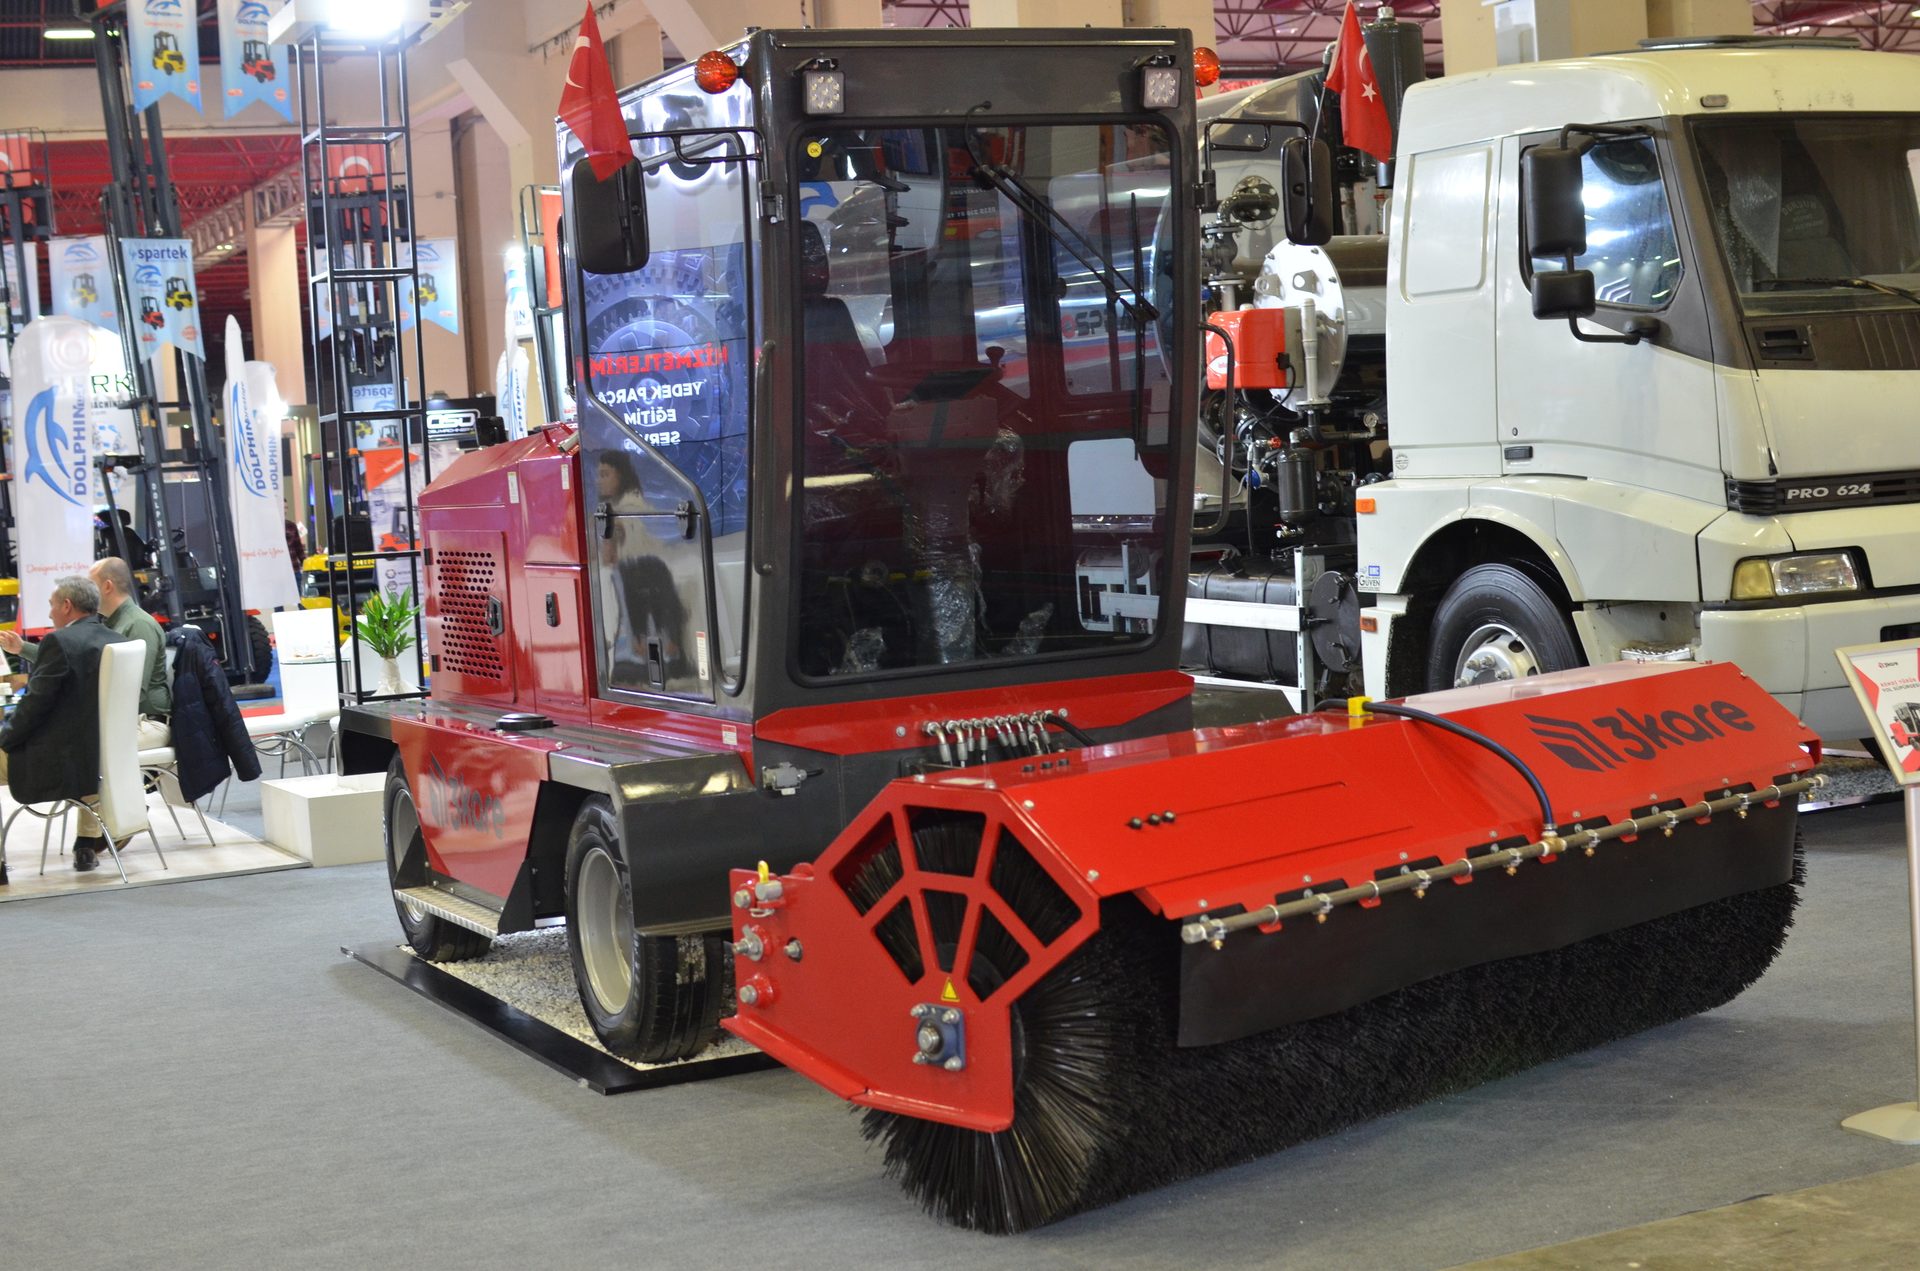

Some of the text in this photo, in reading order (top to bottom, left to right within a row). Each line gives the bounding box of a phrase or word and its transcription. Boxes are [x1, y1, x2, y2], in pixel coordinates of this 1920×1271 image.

[138, 245, 188, 262] spartek
[73, 406, 87, 496] DOLPHIN
[244, 418, 267, 490] DOLPHIN
[1787, 483, 1871, 500] PRO 624
[1591, 700, 1756, 761] 3kare
[447, 773, 505, 840] 3kare
